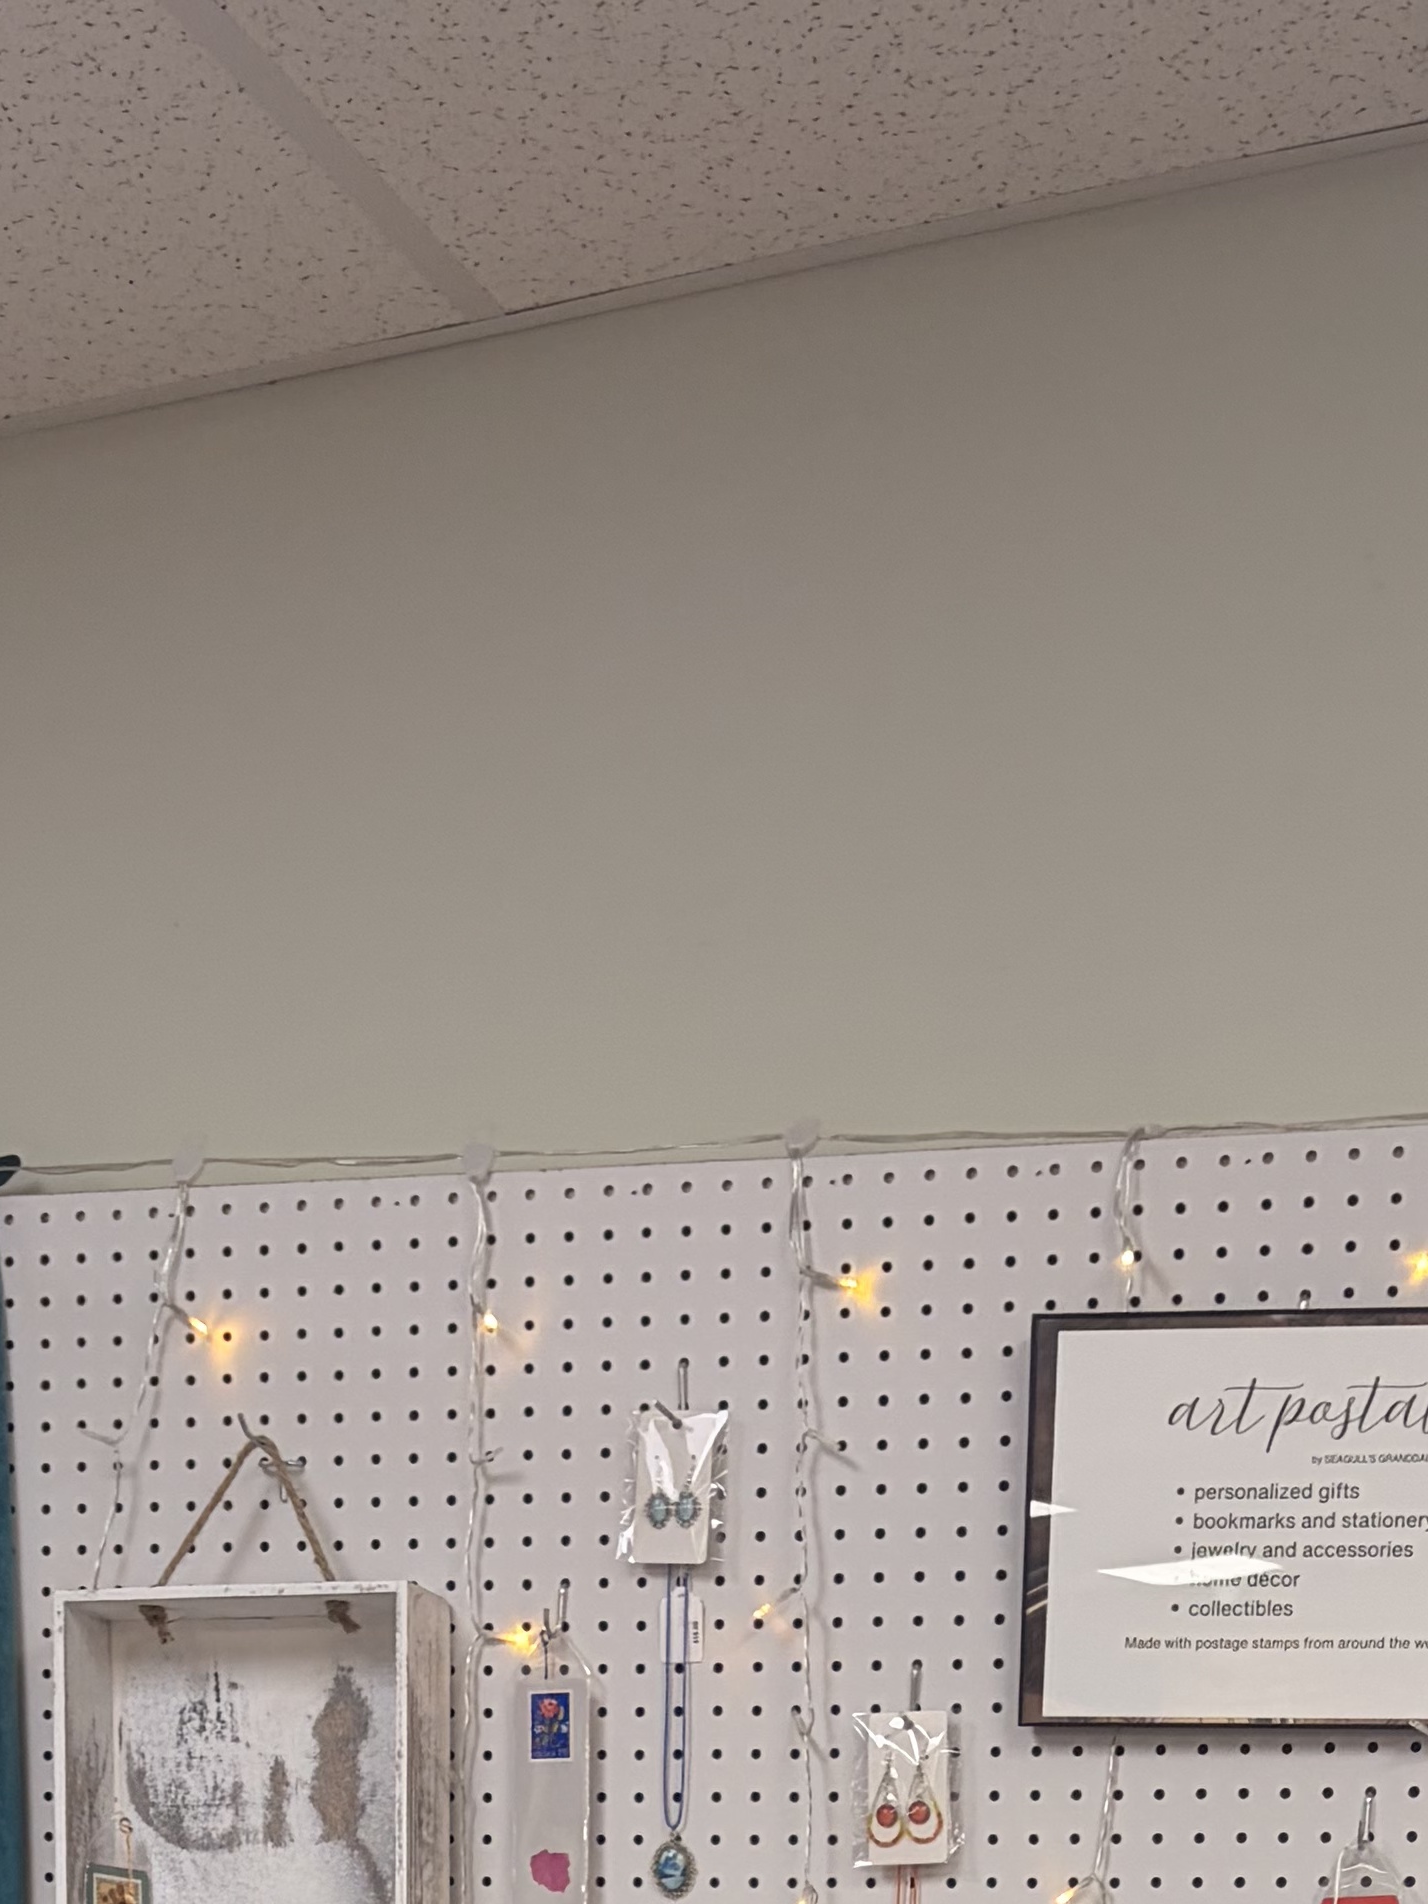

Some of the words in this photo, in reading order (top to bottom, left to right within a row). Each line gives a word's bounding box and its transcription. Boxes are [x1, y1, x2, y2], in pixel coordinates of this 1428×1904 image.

[1168, 1378, 1304, 1435] art
[1194, 1483, 1313, 1503] personalized
[1318, 1482, 1360, 1503] gifts
[1193, 1513, 1296, 1530] bookmarks
[1301, 1512, 1336, 1529] and
[1262, 1541, 1297, 1558] and
[1303, 1541, 1414, 1559] accessories
[1188, 1600, 1293, 1618] collectibles
[1125, 1637, 1161, 1650] Made
[1165, 1637, 1192, 1650] with
[1195, 1638, 1249, 1653] postage
[1252, 1638, 1300, 1652] stamps
[1304, 1636, 1334, 1650] from
[1337, 1637, 1385, 1650] around
[1389, 1636, 1410, 1649] the
